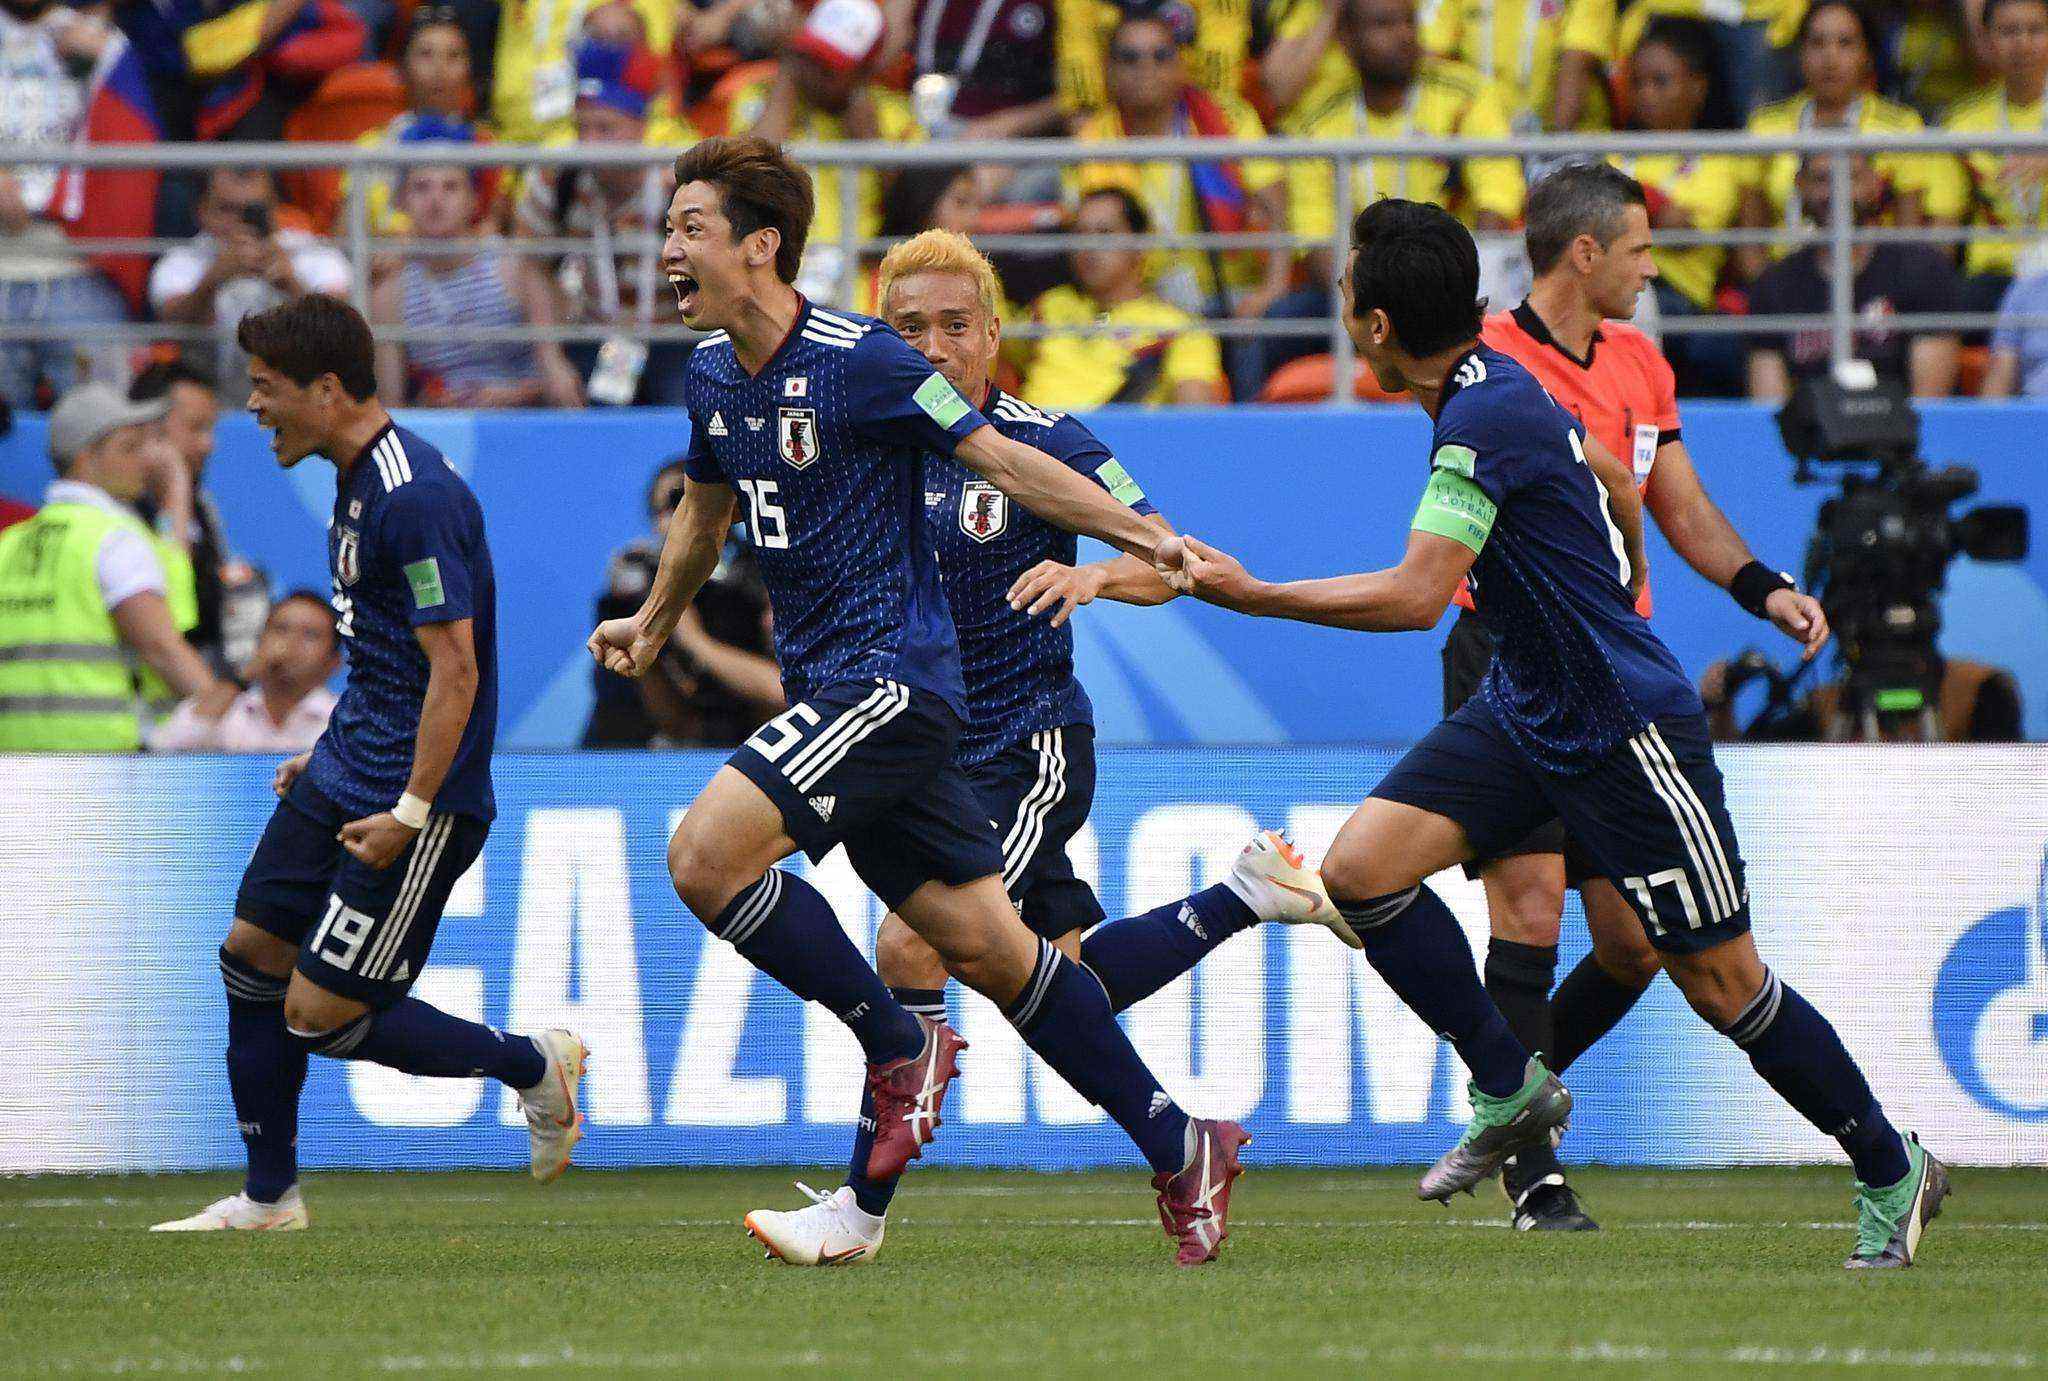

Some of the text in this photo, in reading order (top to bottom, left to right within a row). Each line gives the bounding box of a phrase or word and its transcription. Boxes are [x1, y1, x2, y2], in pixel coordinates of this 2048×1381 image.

[738, 479, 789, 549] 15
[743, 702, 821, 763] 5
[310, 892, 375, 972] 19
[1624, 867, 1702, 936] 17
